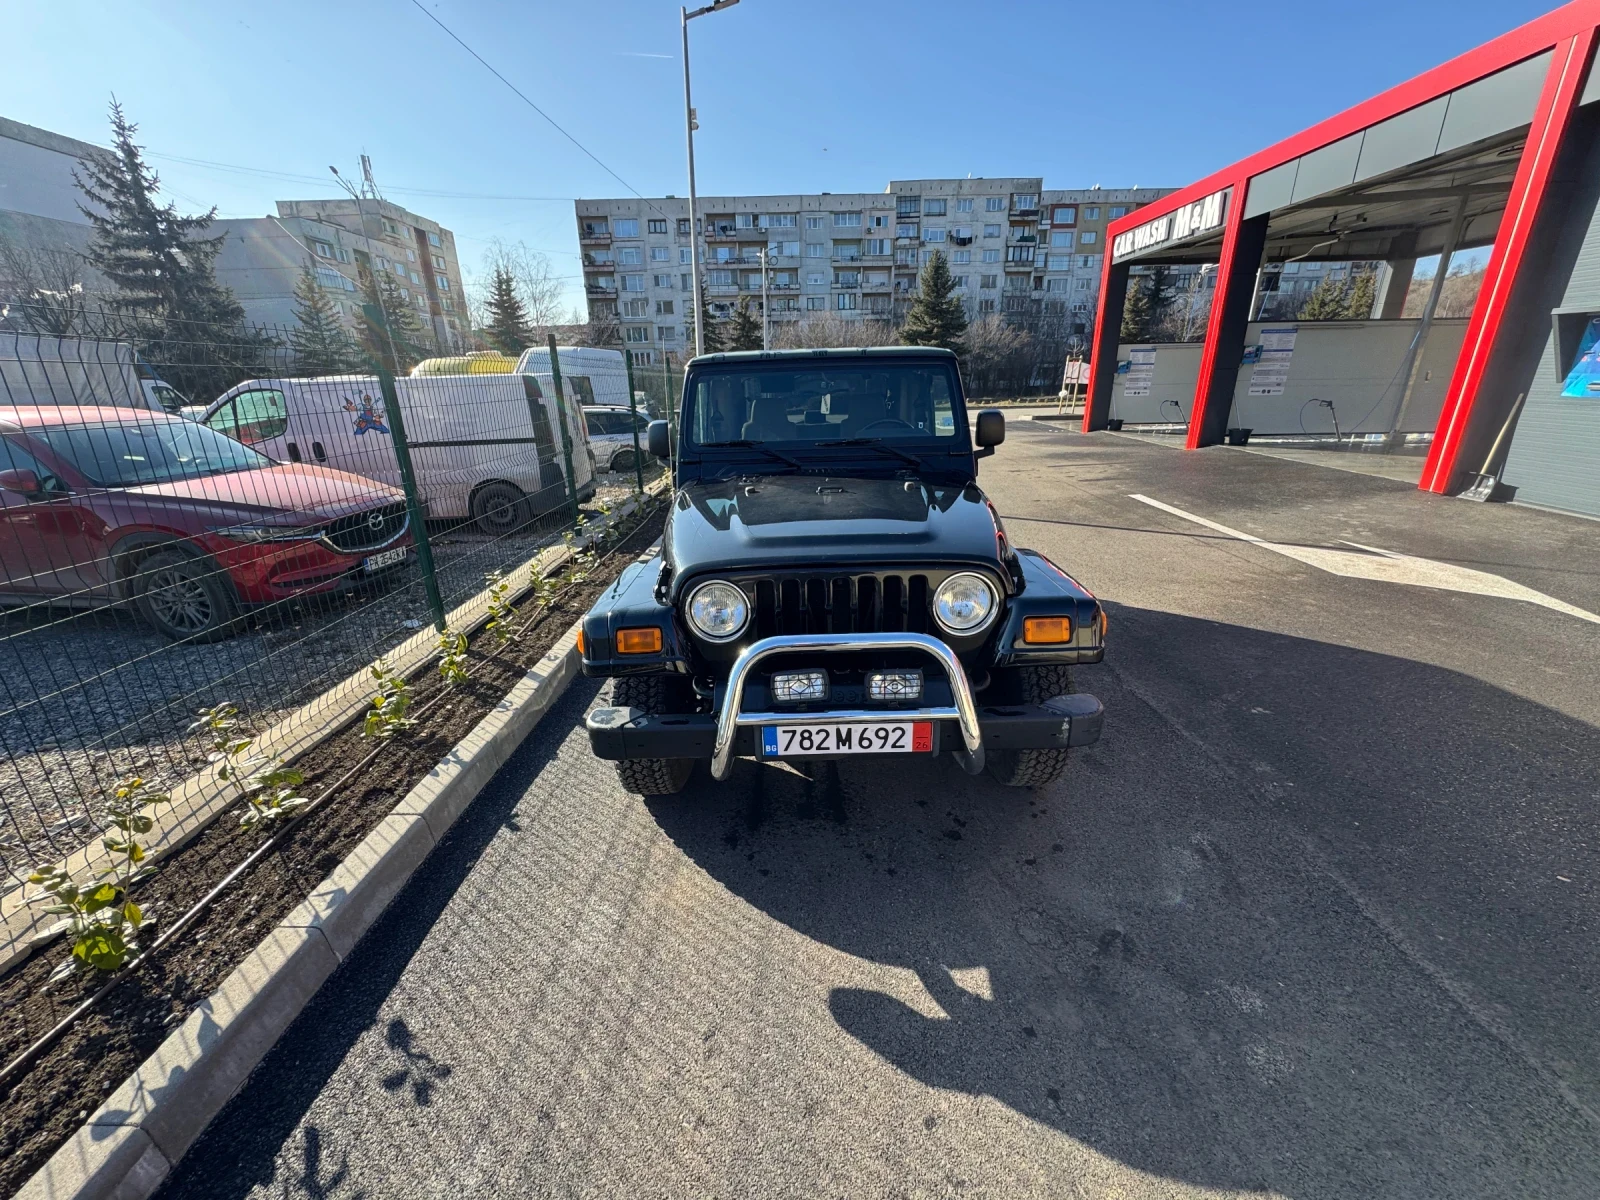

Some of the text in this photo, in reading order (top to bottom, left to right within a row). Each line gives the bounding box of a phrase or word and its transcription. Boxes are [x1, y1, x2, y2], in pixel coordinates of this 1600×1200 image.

[1114, 191, 1222, 257] CAR WASH M&M
[915, 741, 928, 749] 26
